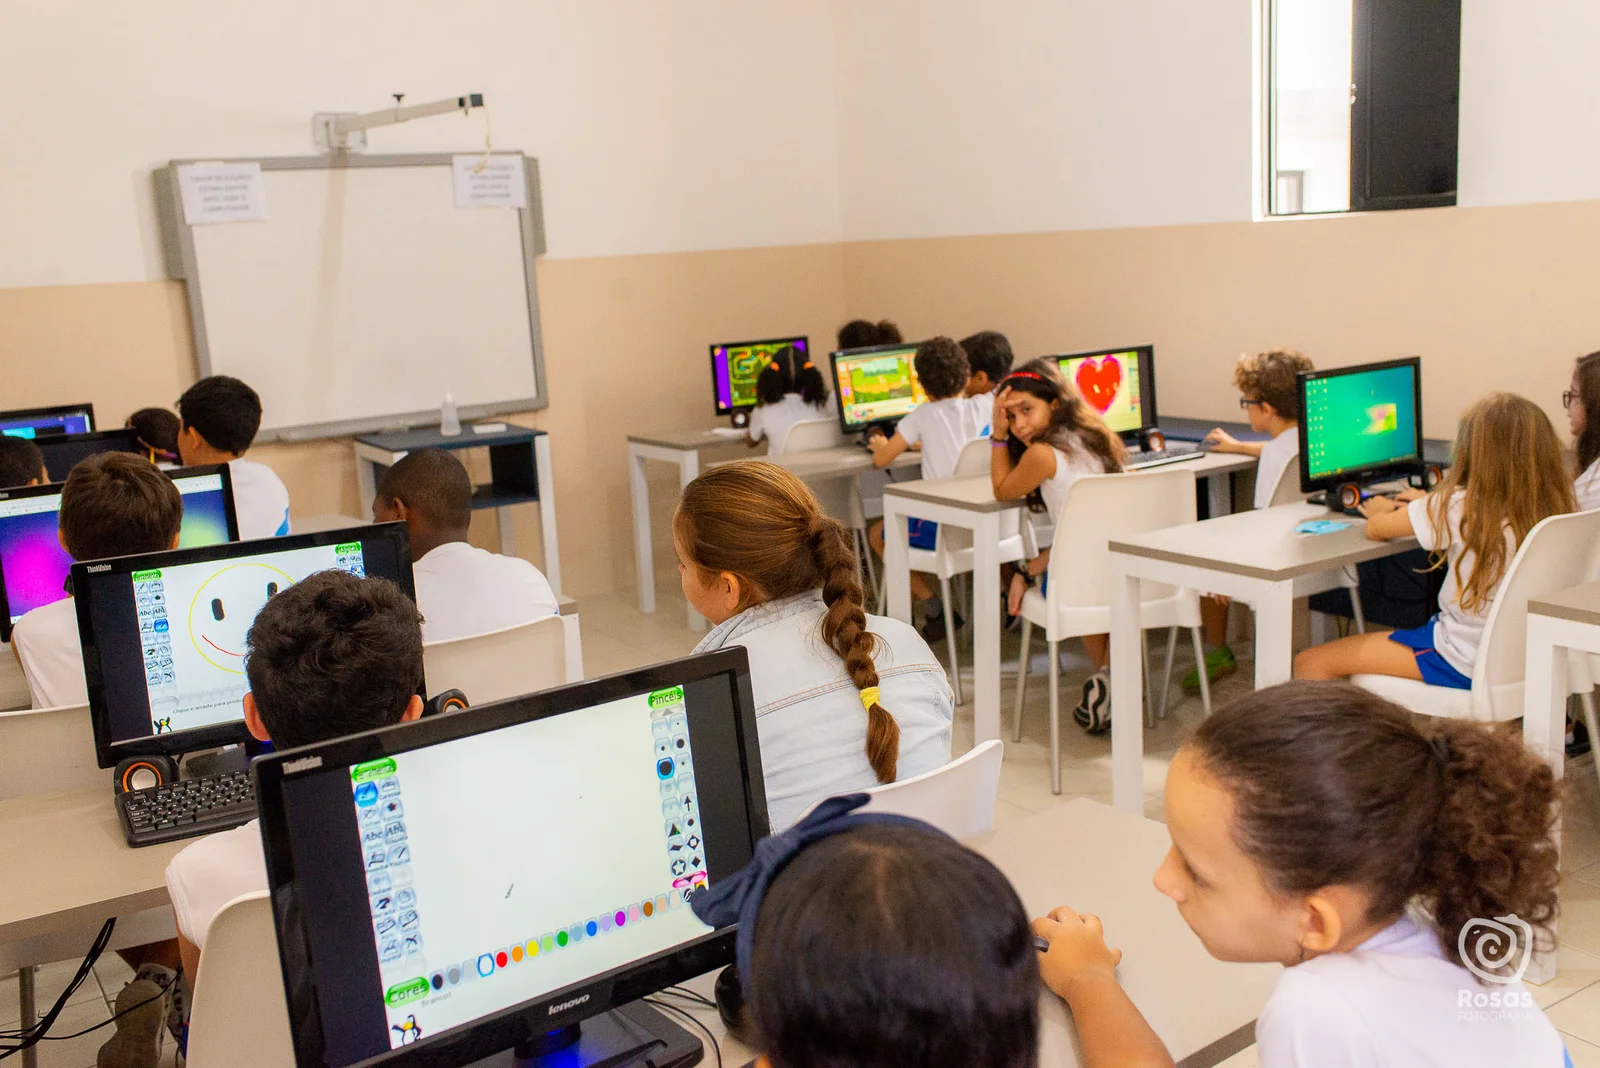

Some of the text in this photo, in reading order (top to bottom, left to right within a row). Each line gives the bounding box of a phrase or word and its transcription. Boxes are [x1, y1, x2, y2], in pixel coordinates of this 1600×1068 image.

[651, 690, 682, 706] Pincéis
[364, 831, 382, 842] Abc
[388, 983, 426, 1003] Cores
[548, 994, 590, 1015] lenovo
